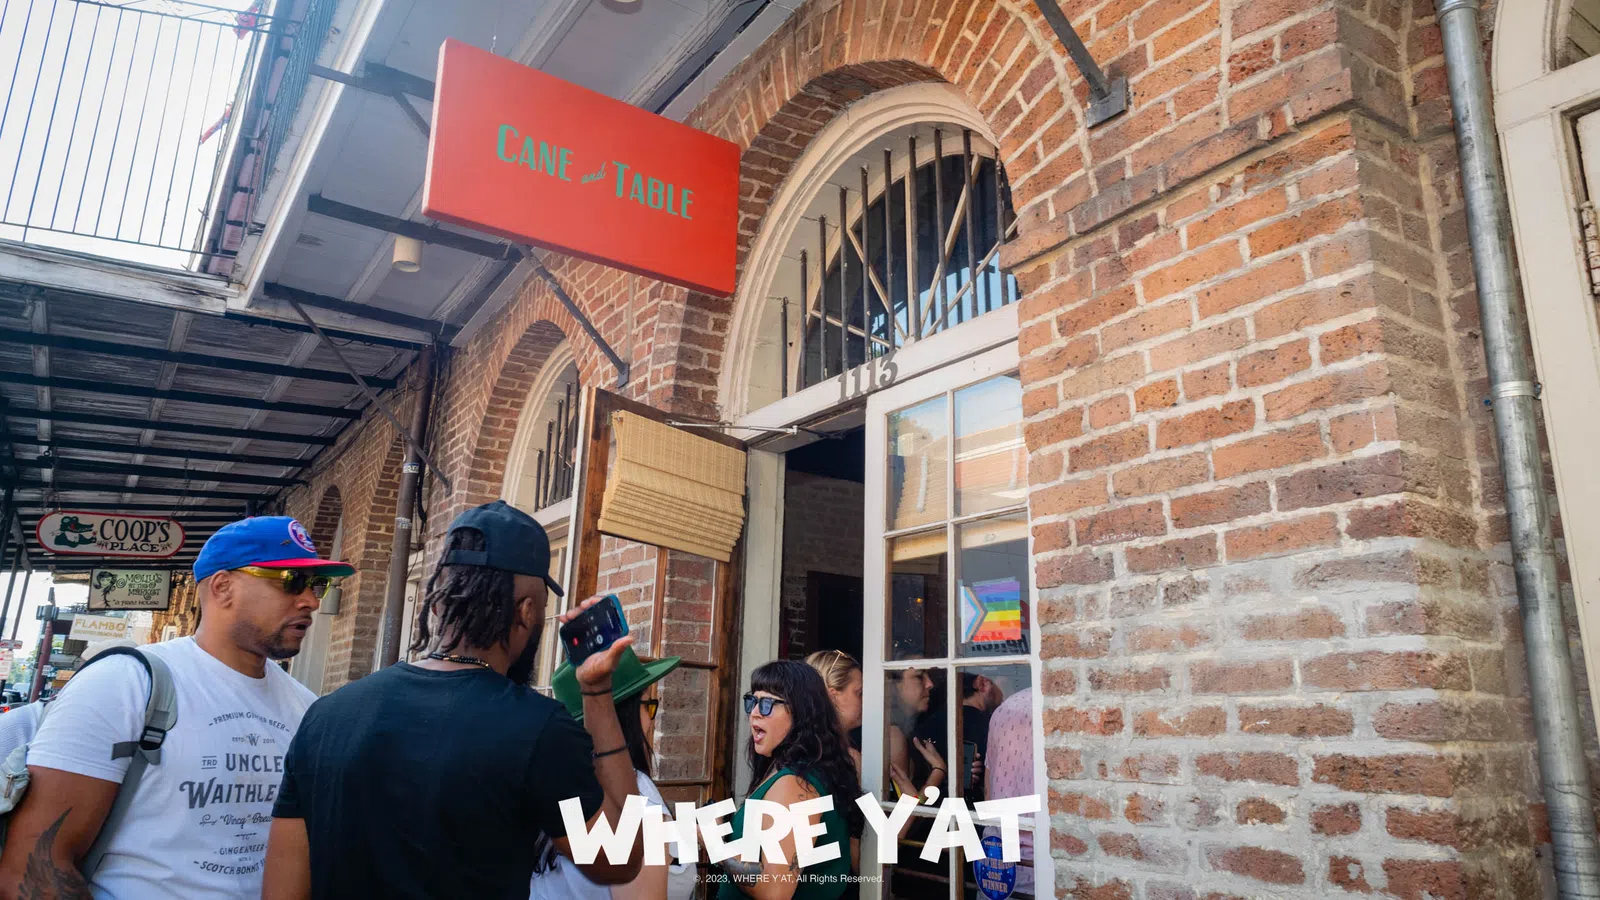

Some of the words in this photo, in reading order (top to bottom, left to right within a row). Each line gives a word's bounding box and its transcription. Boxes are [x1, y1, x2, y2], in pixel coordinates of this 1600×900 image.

[496, 123, 574, 182] CANE
[581, 161, 606, 184] and
[612, 160, 694, 220] TABLE
[837, 350, 898, 405] 1113
[100, 518, 171, 543] COOP'S
[109, 541, 160, 552] PLACE
[213, 711, 245, 725] PREMIUM
[268, 719, 287, 731] BEER
[202, 759, 218, 767] TRD
[225, 753, 283, 773] UNCLE
[179, 776, 281, 809] WAITHLE
[200, 861, 235, 875] SCOTCH
